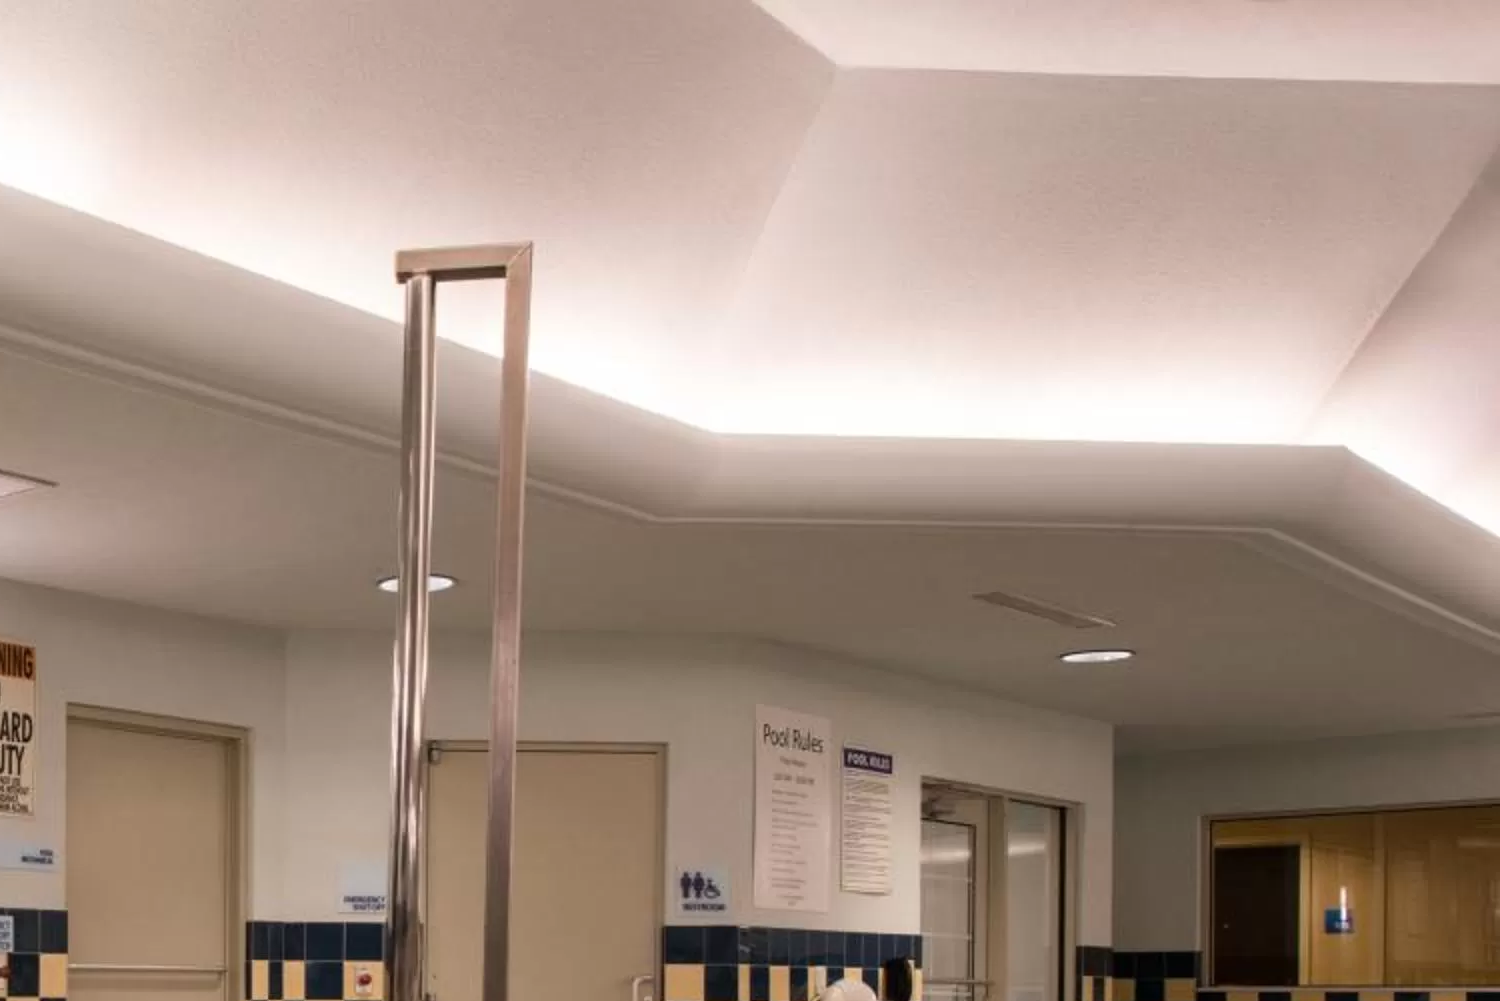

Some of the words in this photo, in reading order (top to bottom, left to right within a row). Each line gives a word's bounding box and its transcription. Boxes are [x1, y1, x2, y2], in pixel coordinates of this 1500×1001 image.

[763, 723, 789, 748] Pool
[792, 729, 824, 753] Rules
[848, 751, 869, 767] POOL
